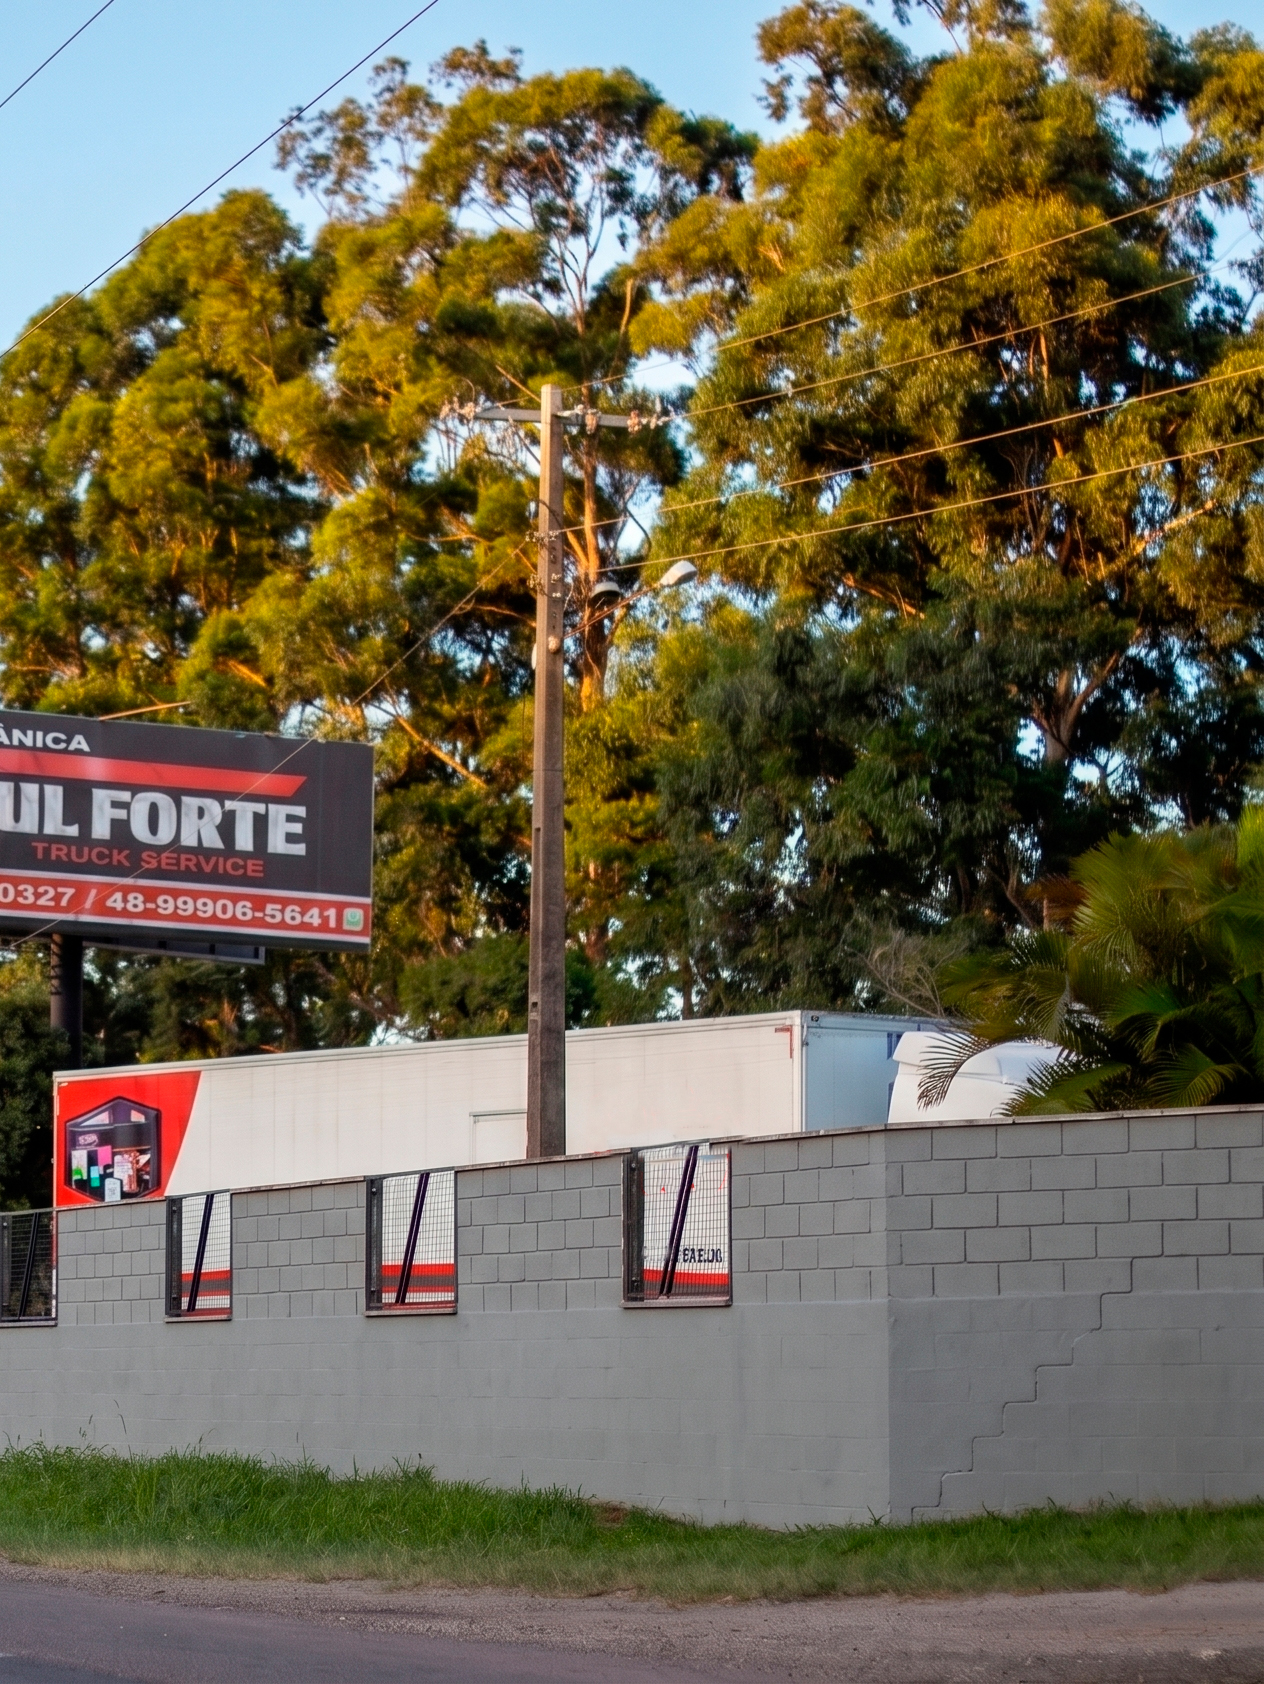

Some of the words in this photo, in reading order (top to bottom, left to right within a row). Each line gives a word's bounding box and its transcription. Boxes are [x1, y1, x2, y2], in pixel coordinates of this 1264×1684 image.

[91, 788, 307, 856] FORTE
[31, 842, 131, 867] TRUCK
[140, 851, 265, 878] SERVICE
[106, 891, 337, 928] 48-99906-5641
